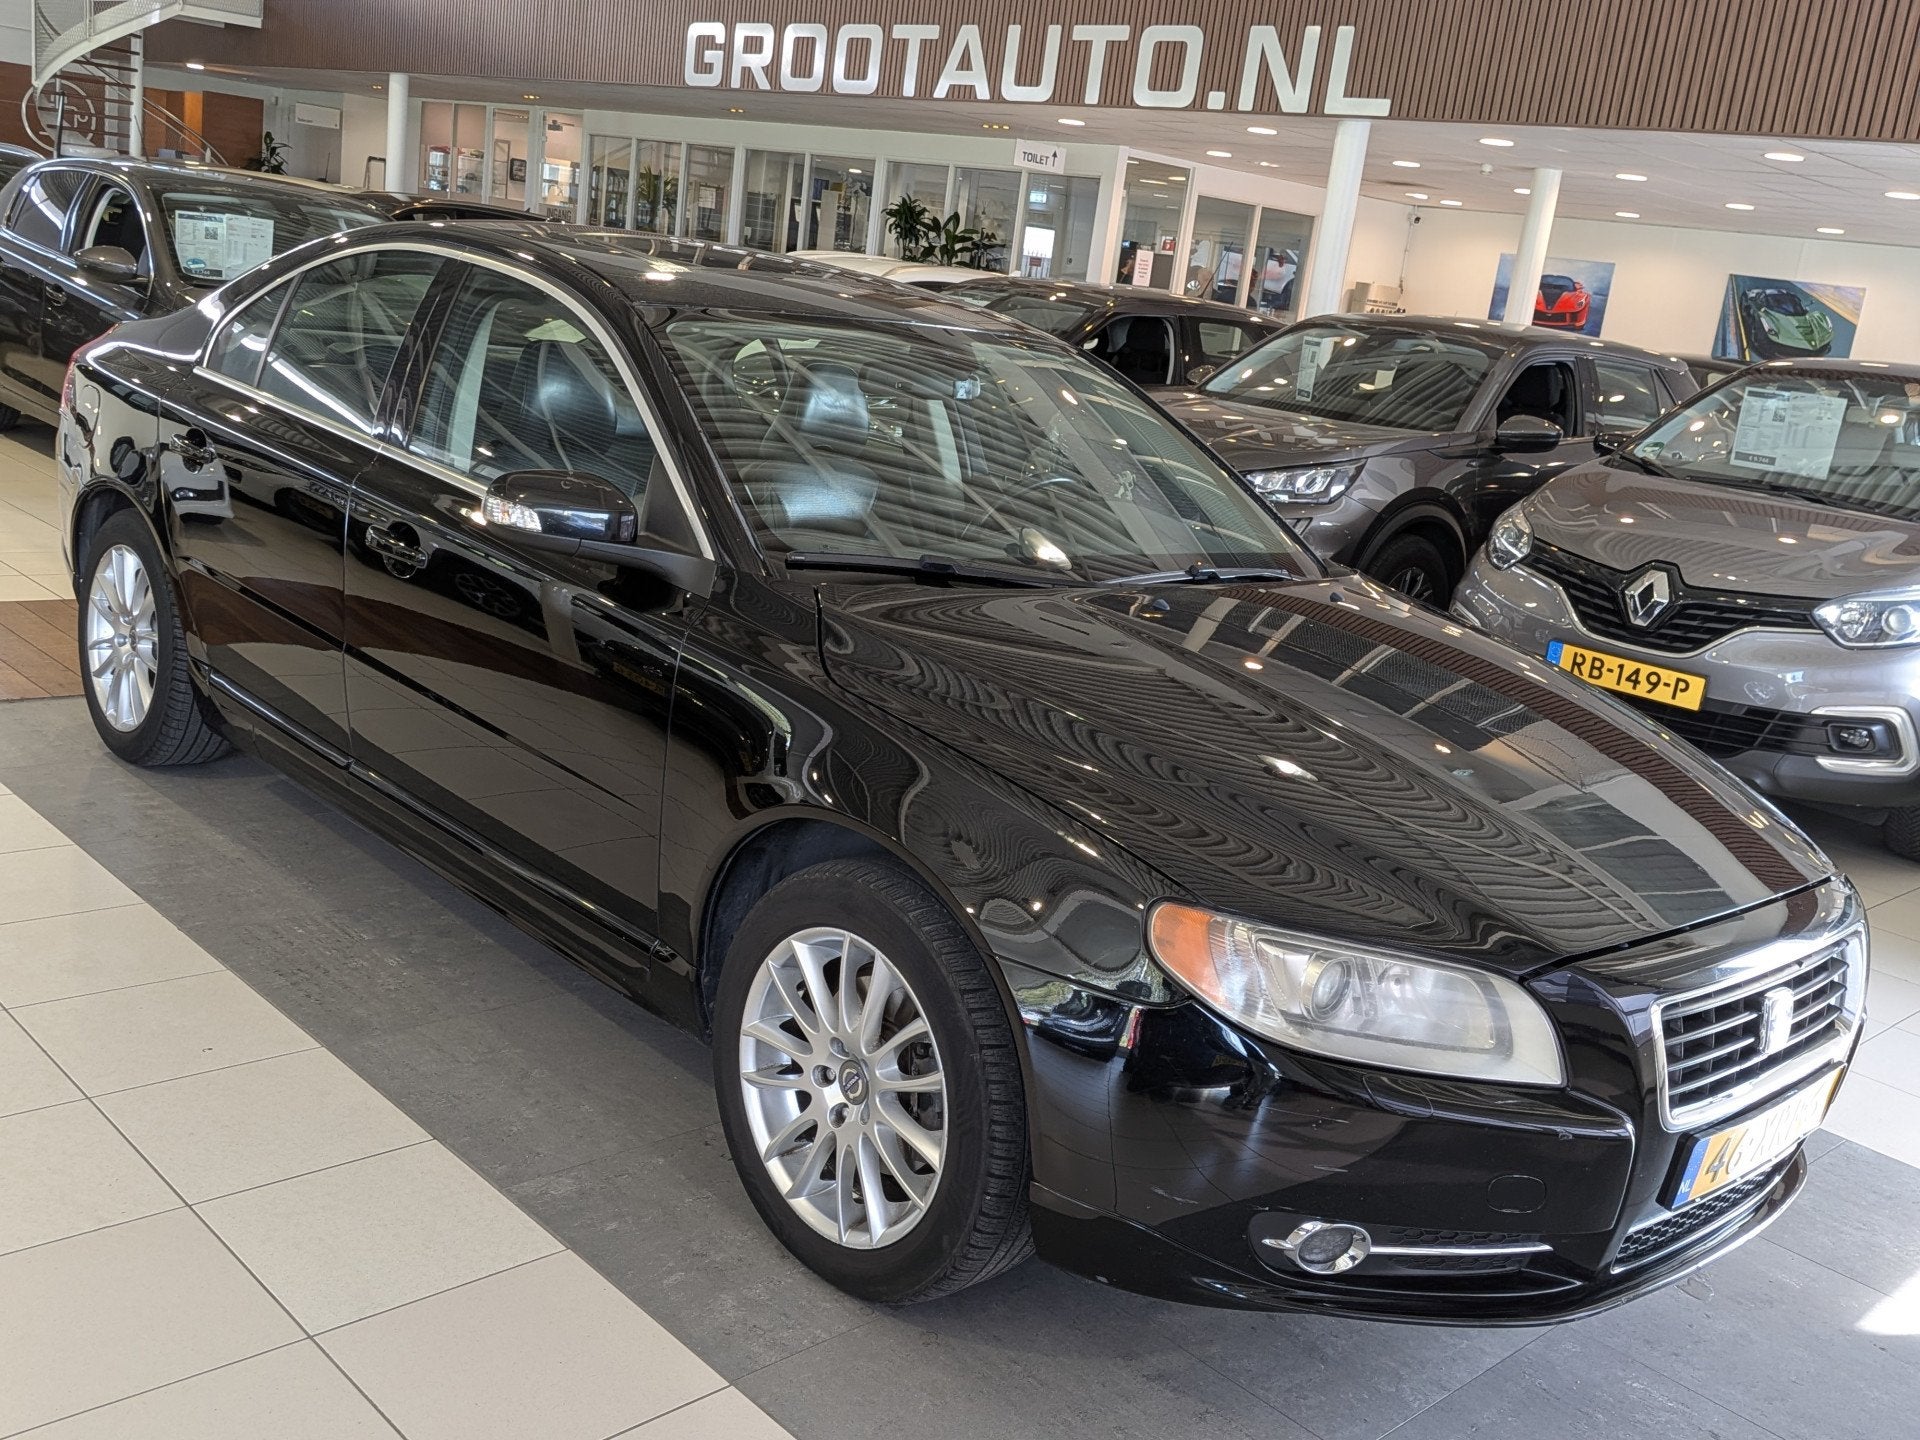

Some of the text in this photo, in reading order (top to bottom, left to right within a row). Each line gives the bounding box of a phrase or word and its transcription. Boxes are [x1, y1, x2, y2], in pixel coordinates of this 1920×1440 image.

[685, 22, 1390, 117] GROOTAUTO.NL
[1022, 151, 1050, 166] TOILET
[1570, 651, 1690, 701] RB-149-P
[1679, 1179, 1691, 1194] NL
